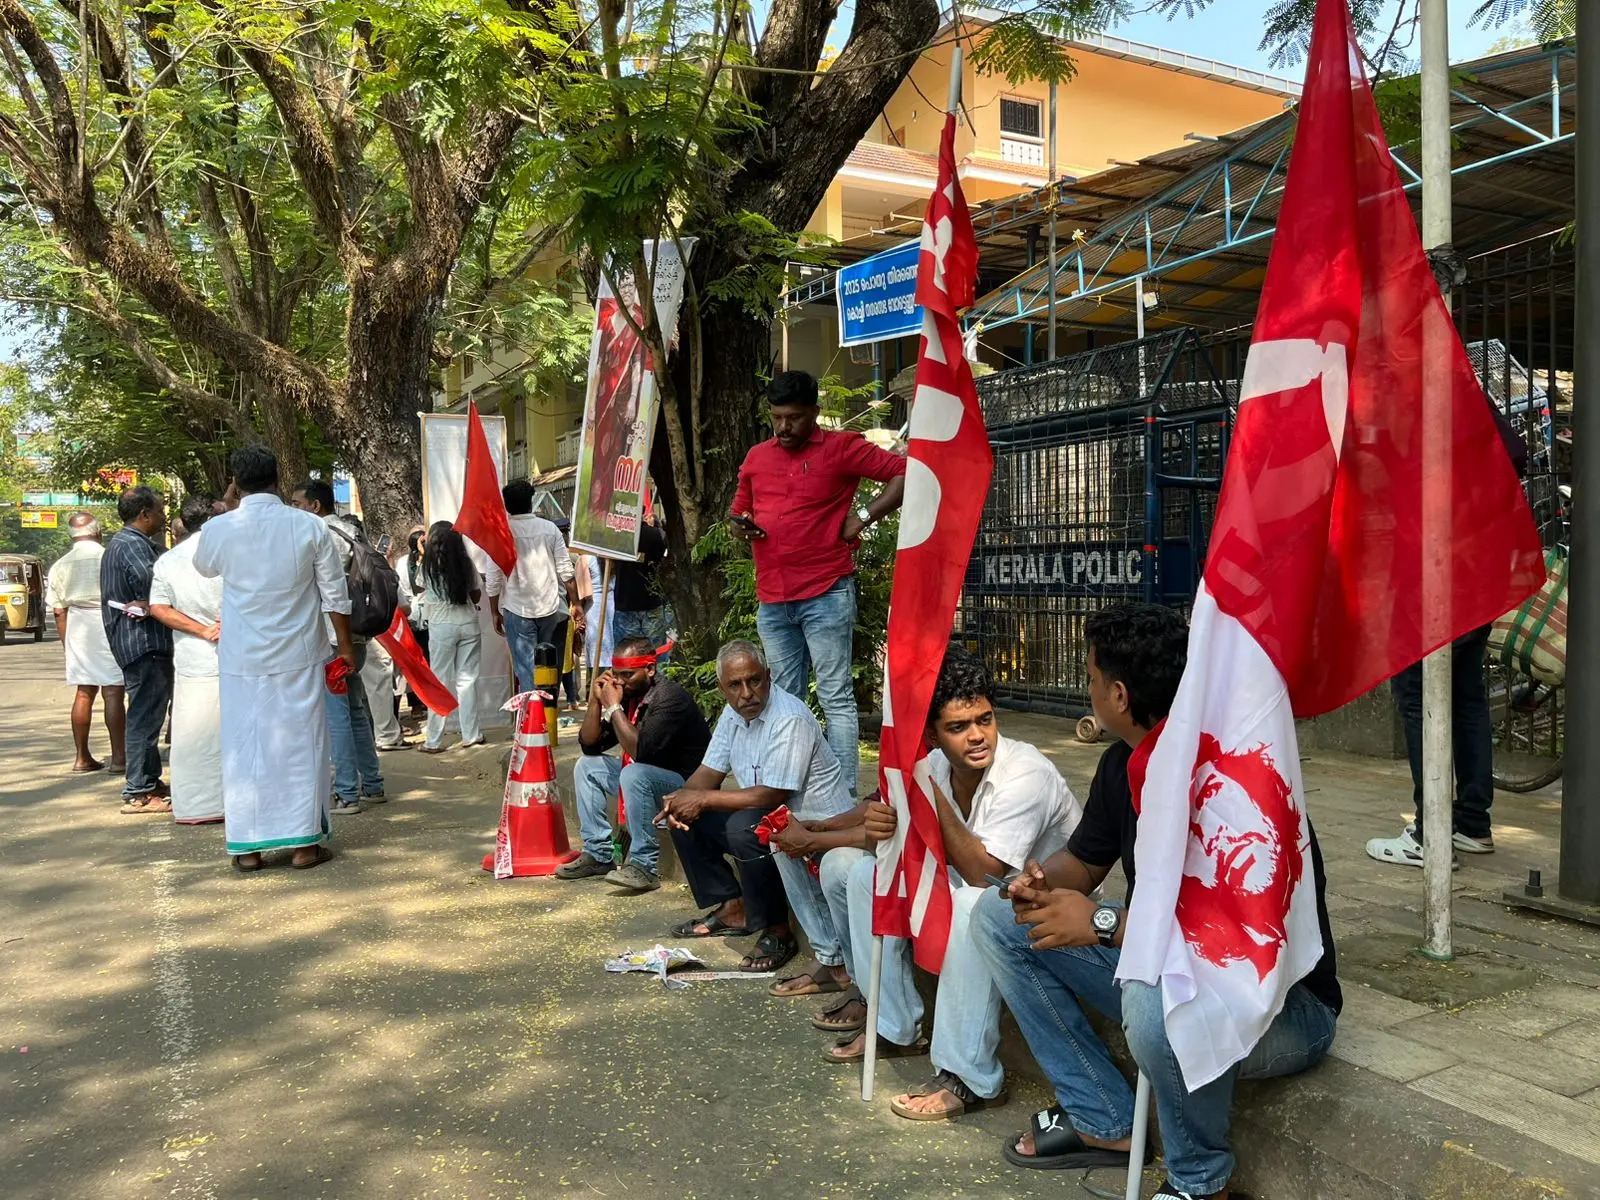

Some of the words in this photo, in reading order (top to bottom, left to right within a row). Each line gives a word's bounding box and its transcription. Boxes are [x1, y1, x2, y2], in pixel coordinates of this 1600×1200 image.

[844, 279, 860, 295] 2025
[984, 553, 1066, 584] KERALA
[1072, 550, 1158, 584] POLIC
